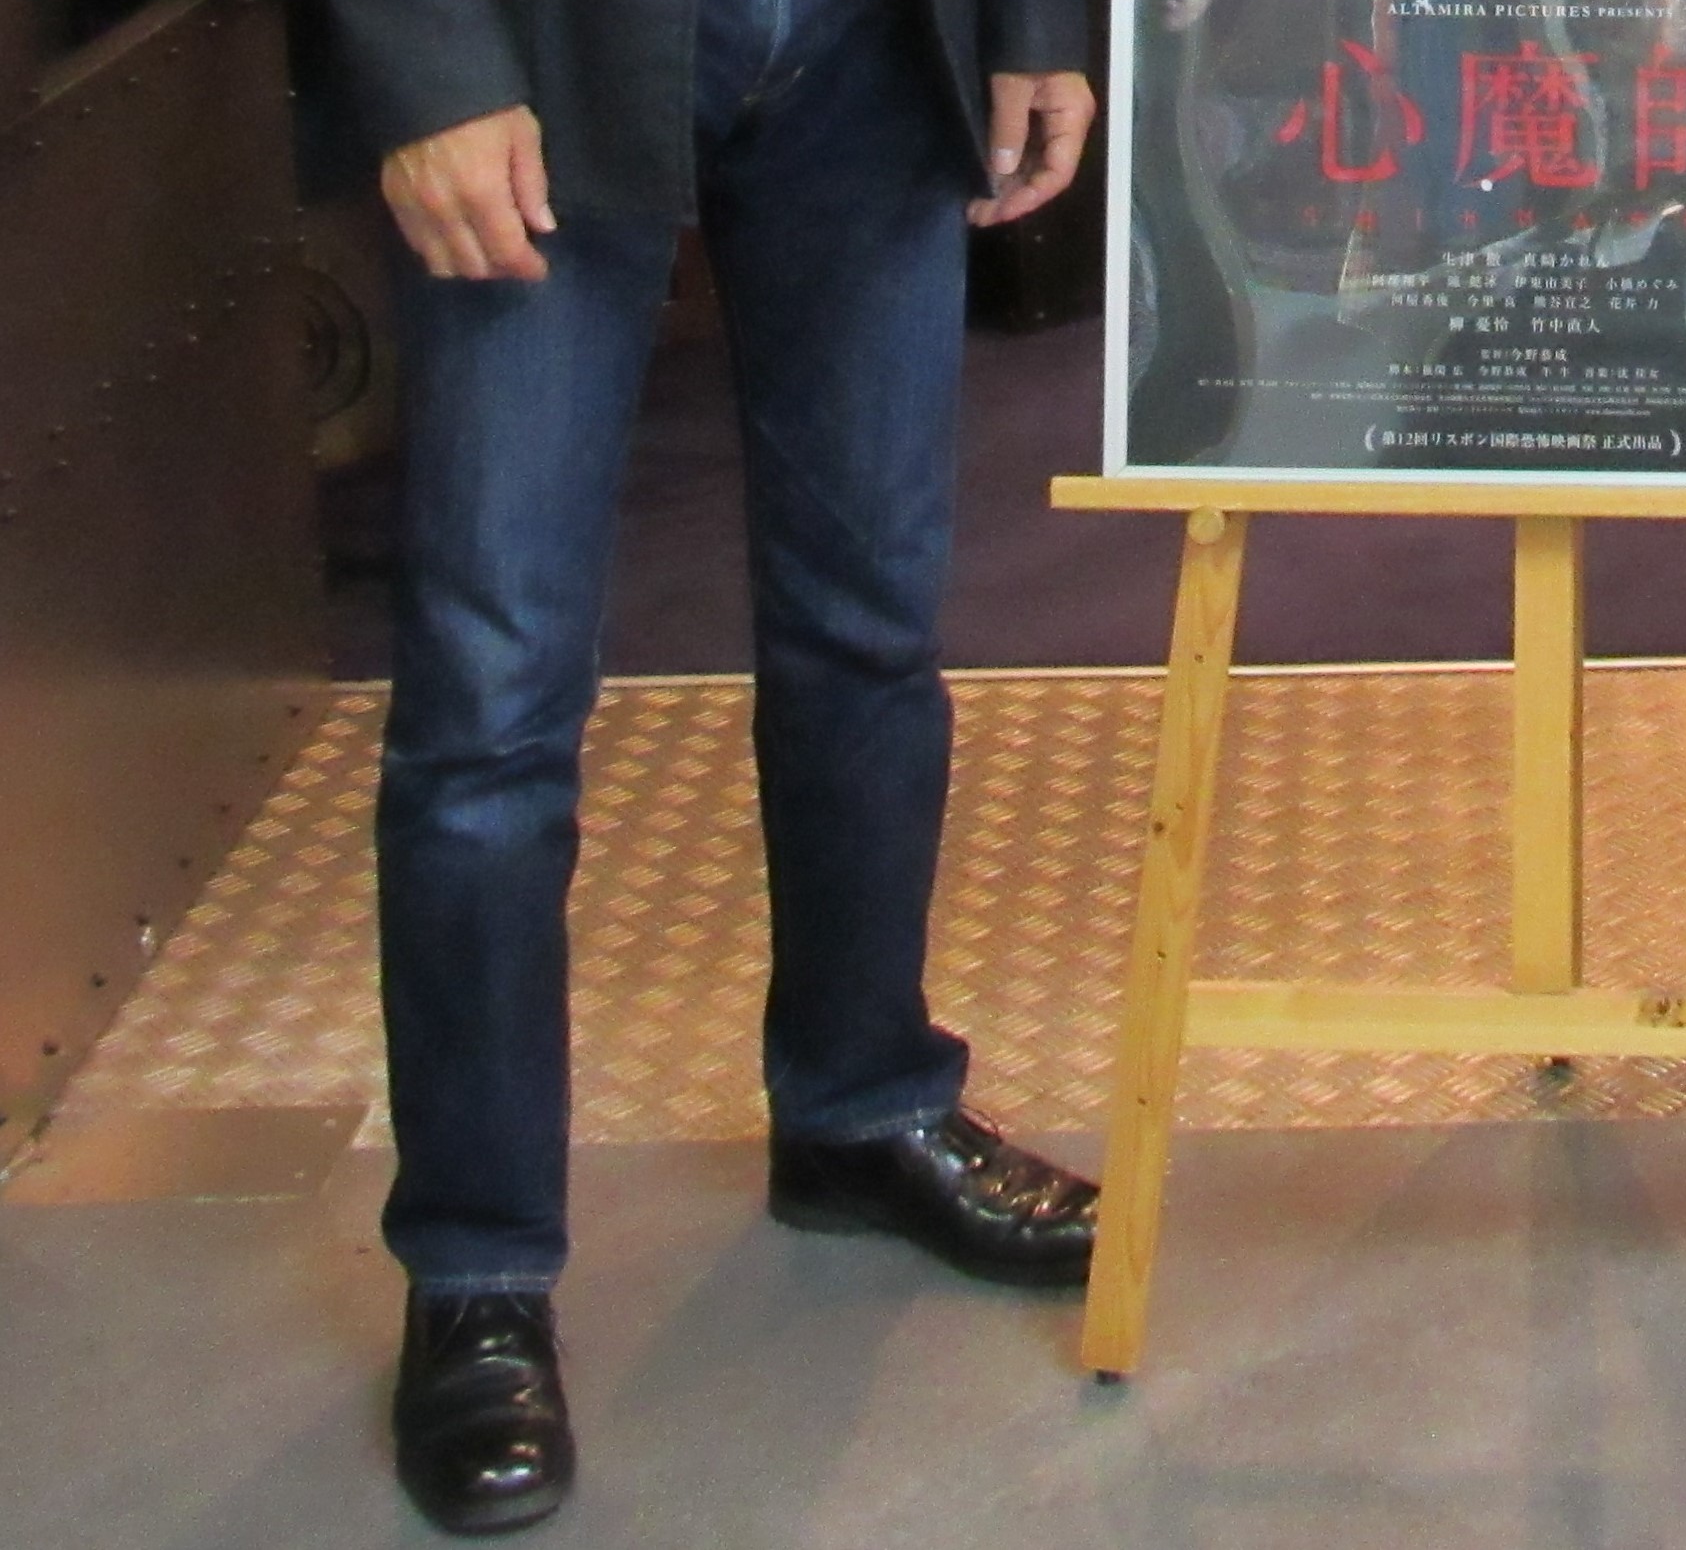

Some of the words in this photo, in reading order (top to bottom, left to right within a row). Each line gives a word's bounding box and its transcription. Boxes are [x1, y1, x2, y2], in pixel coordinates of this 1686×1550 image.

[1386, 1, 1486, 16] ALTAMIRA
[1494, 2, 1591, 18] PICTURES
[1598, 6, 1674, 18] PRESENTS
[1603, 432, 1662, 450] 正式出品
